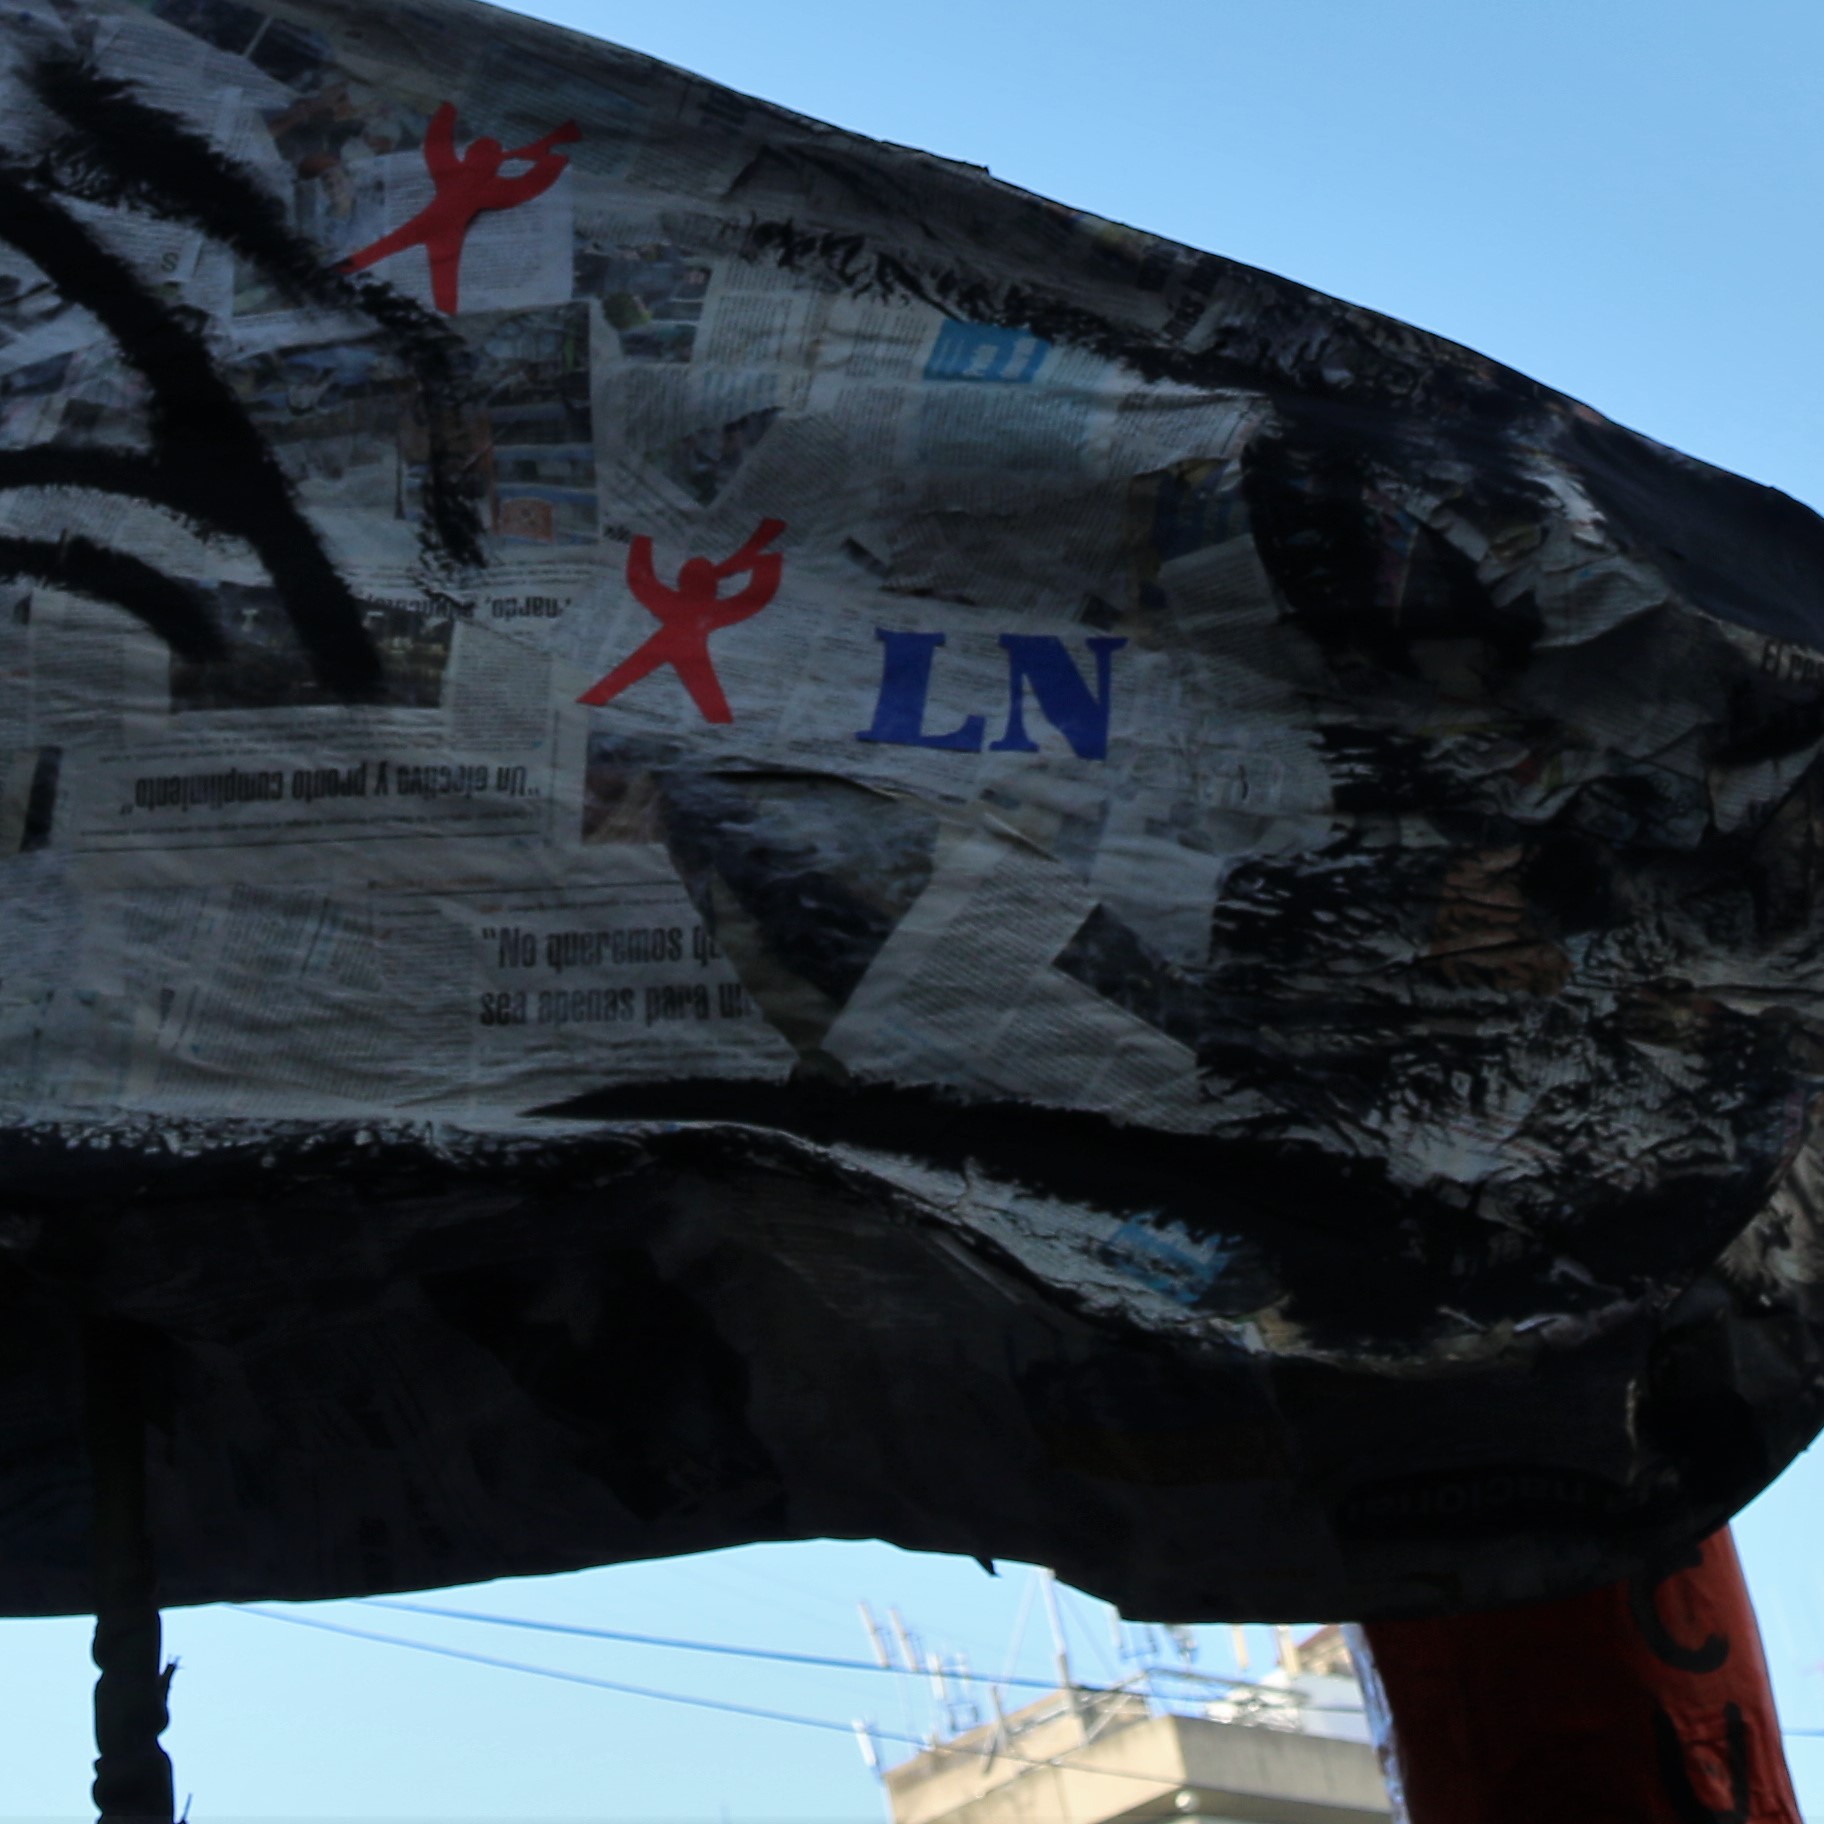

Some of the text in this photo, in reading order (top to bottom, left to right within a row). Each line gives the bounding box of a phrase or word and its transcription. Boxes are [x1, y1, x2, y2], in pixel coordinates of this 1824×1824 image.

[857, 627, 1128, 761] LN
[544, 926, 683, 974] queremos
[479, 990, 527, 1026] sea
[537, 986, 635, 1030] apenas
[644, 982, 710, 1028] para
